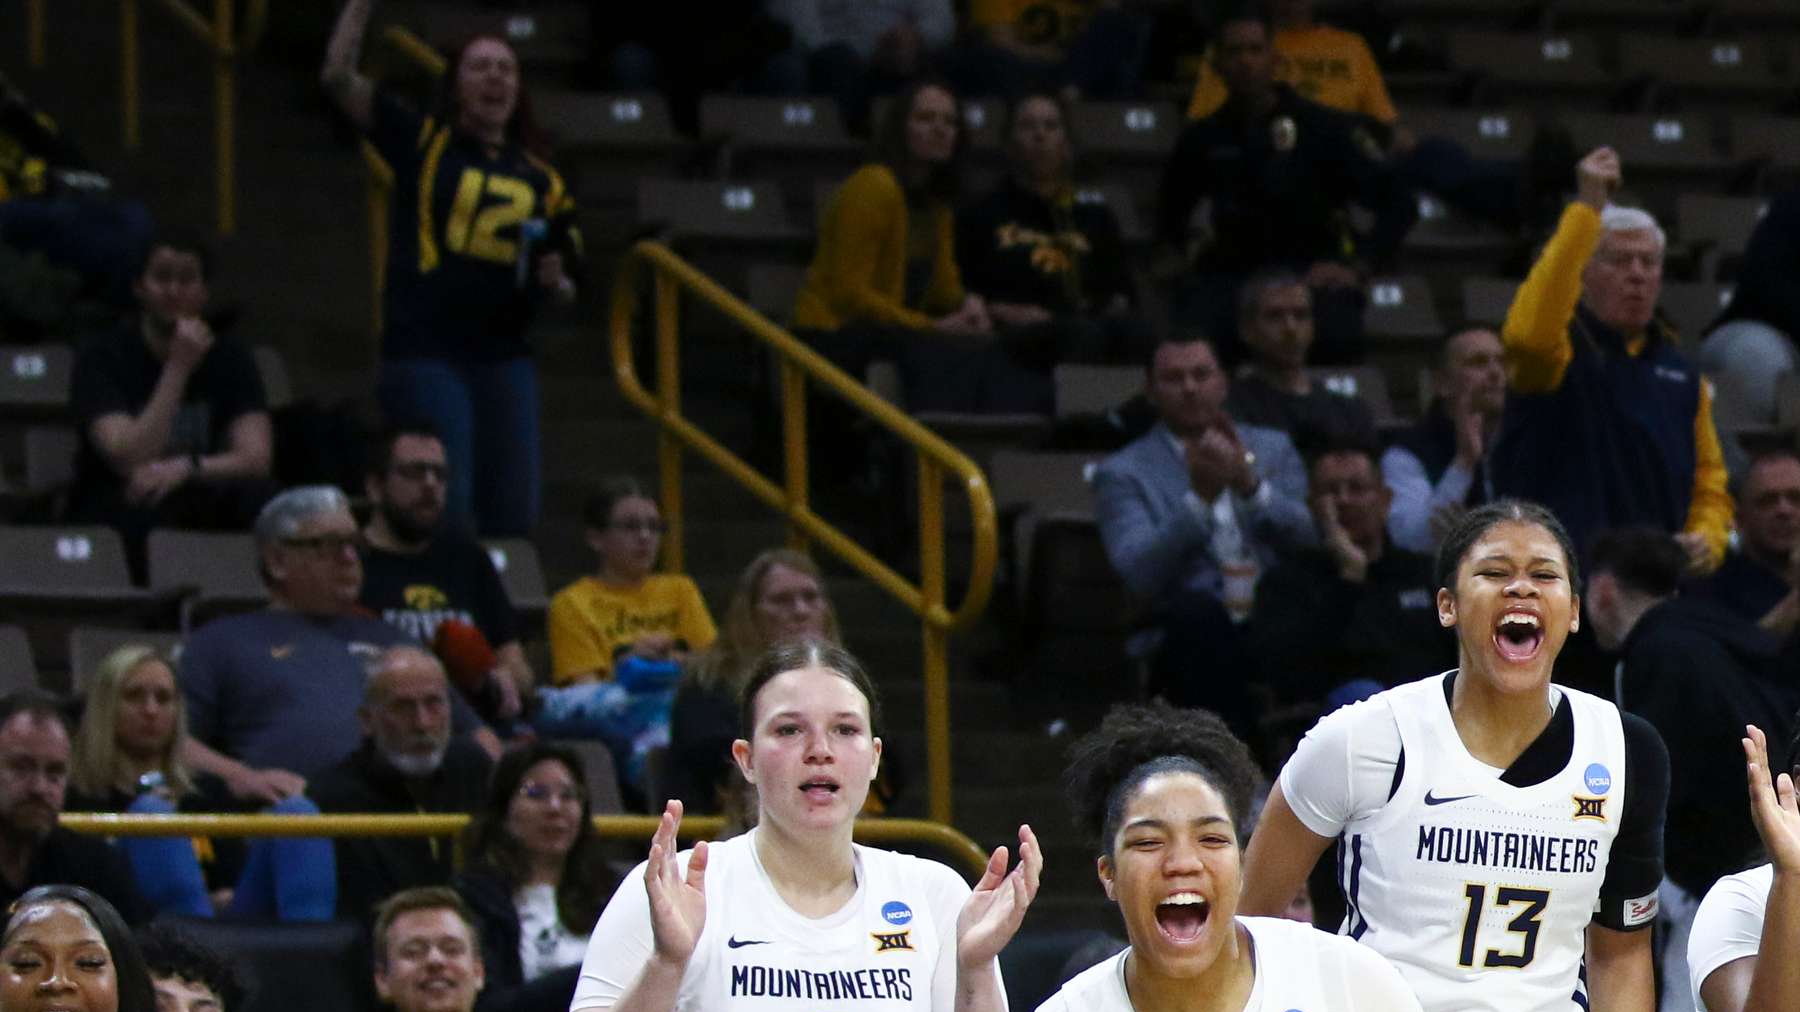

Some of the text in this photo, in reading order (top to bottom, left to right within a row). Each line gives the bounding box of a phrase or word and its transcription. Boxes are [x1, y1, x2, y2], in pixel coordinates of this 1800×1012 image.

[446, 168, 536, 266] 12
[1417, 825, 1600, 874] MOUNTAINEERS
[1458, 881, 1552, 970] 13
[731, 964, 912, 1002] MOUNTAINEERS
